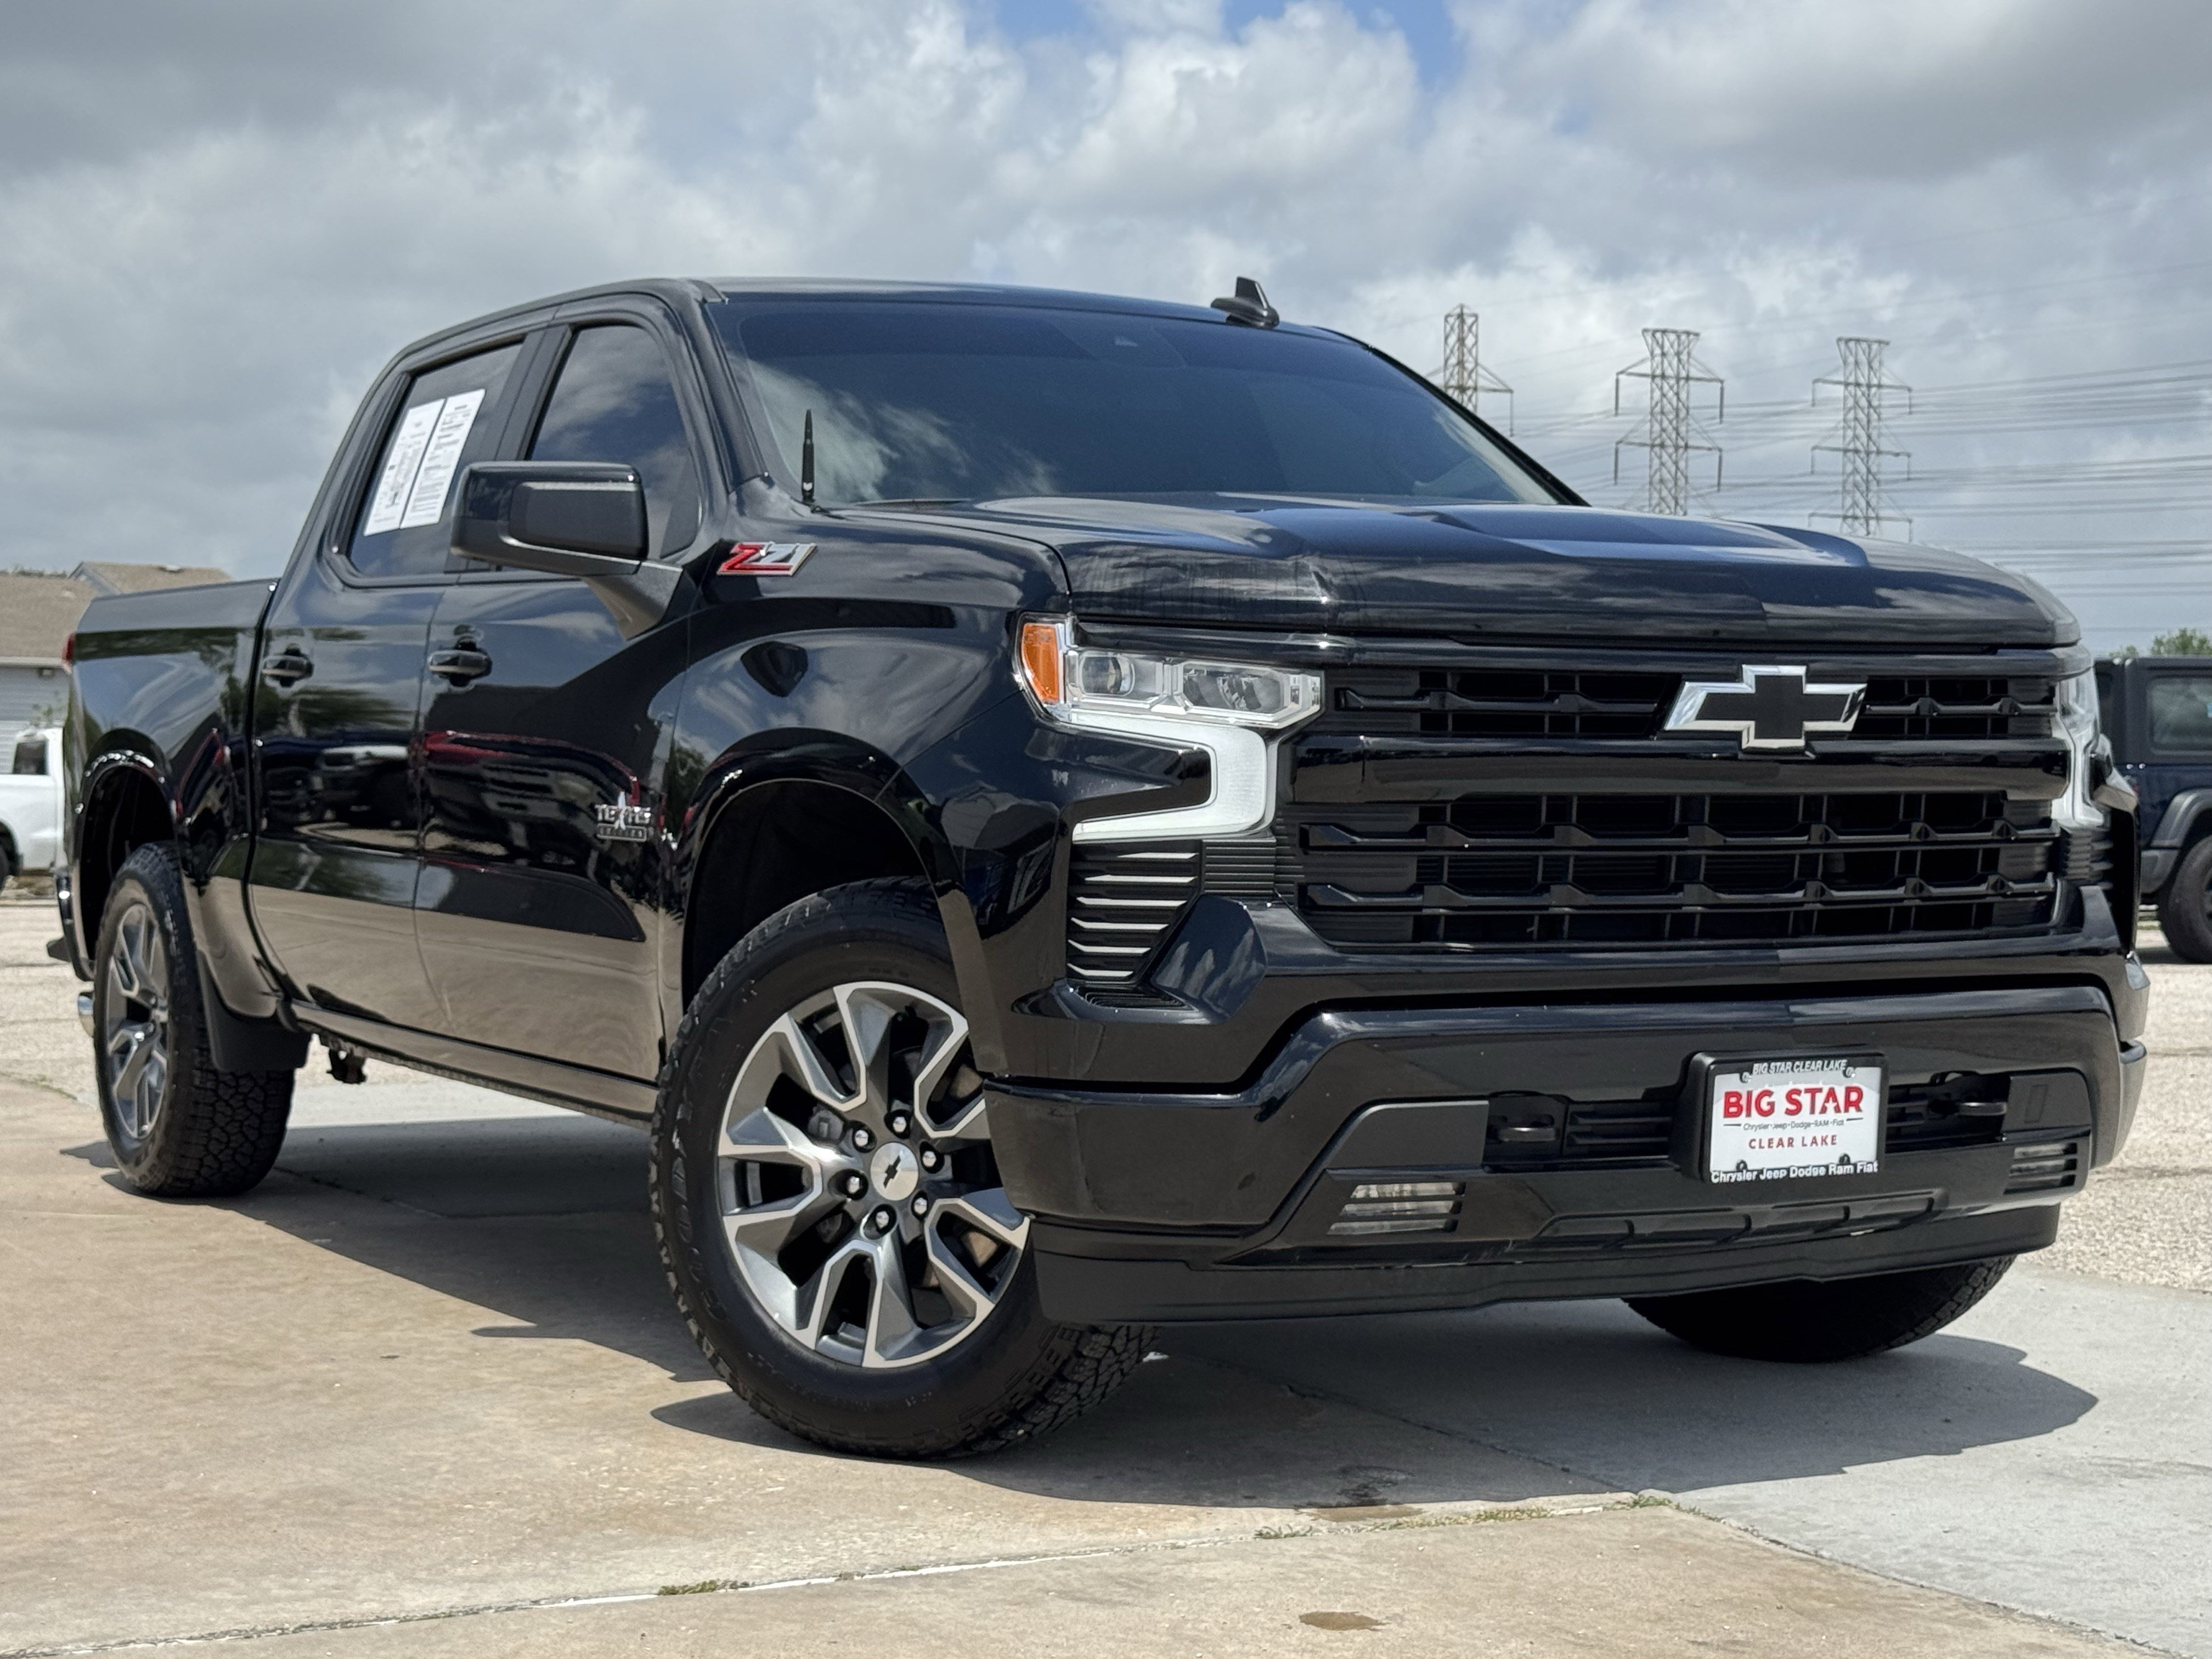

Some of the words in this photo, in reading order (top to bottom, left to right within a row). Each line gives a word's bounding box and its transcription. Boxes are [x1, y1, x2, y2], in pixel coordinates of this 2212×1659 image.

[716, 541, 817, 576] Z71
[1752, 1062, 1769, 1075] BIG
[1769, 1062, 1793, 1074] STAR
[1793, 1060, 1823, 1073] CLEAR
[1824, 1059, 1848, 1071] LAKE
[1723, 1089, 1775, 1118] BIG
[1784, 1086, 1864, 1116] STAR
[1748, 1136, 1795, 1149] CLEAR
[1802, 1135, 1837, 1148] LAKE
[1711, 1170, 1758, 1184] Chrysler
[1759, 1167, 1787, 1180] Jeep
[1789, 1165, 1826, 1178] Dodge
[1829, 1162, 1854, 1175] Ram
[1857, 1160, 1878, 1173] Fiat
